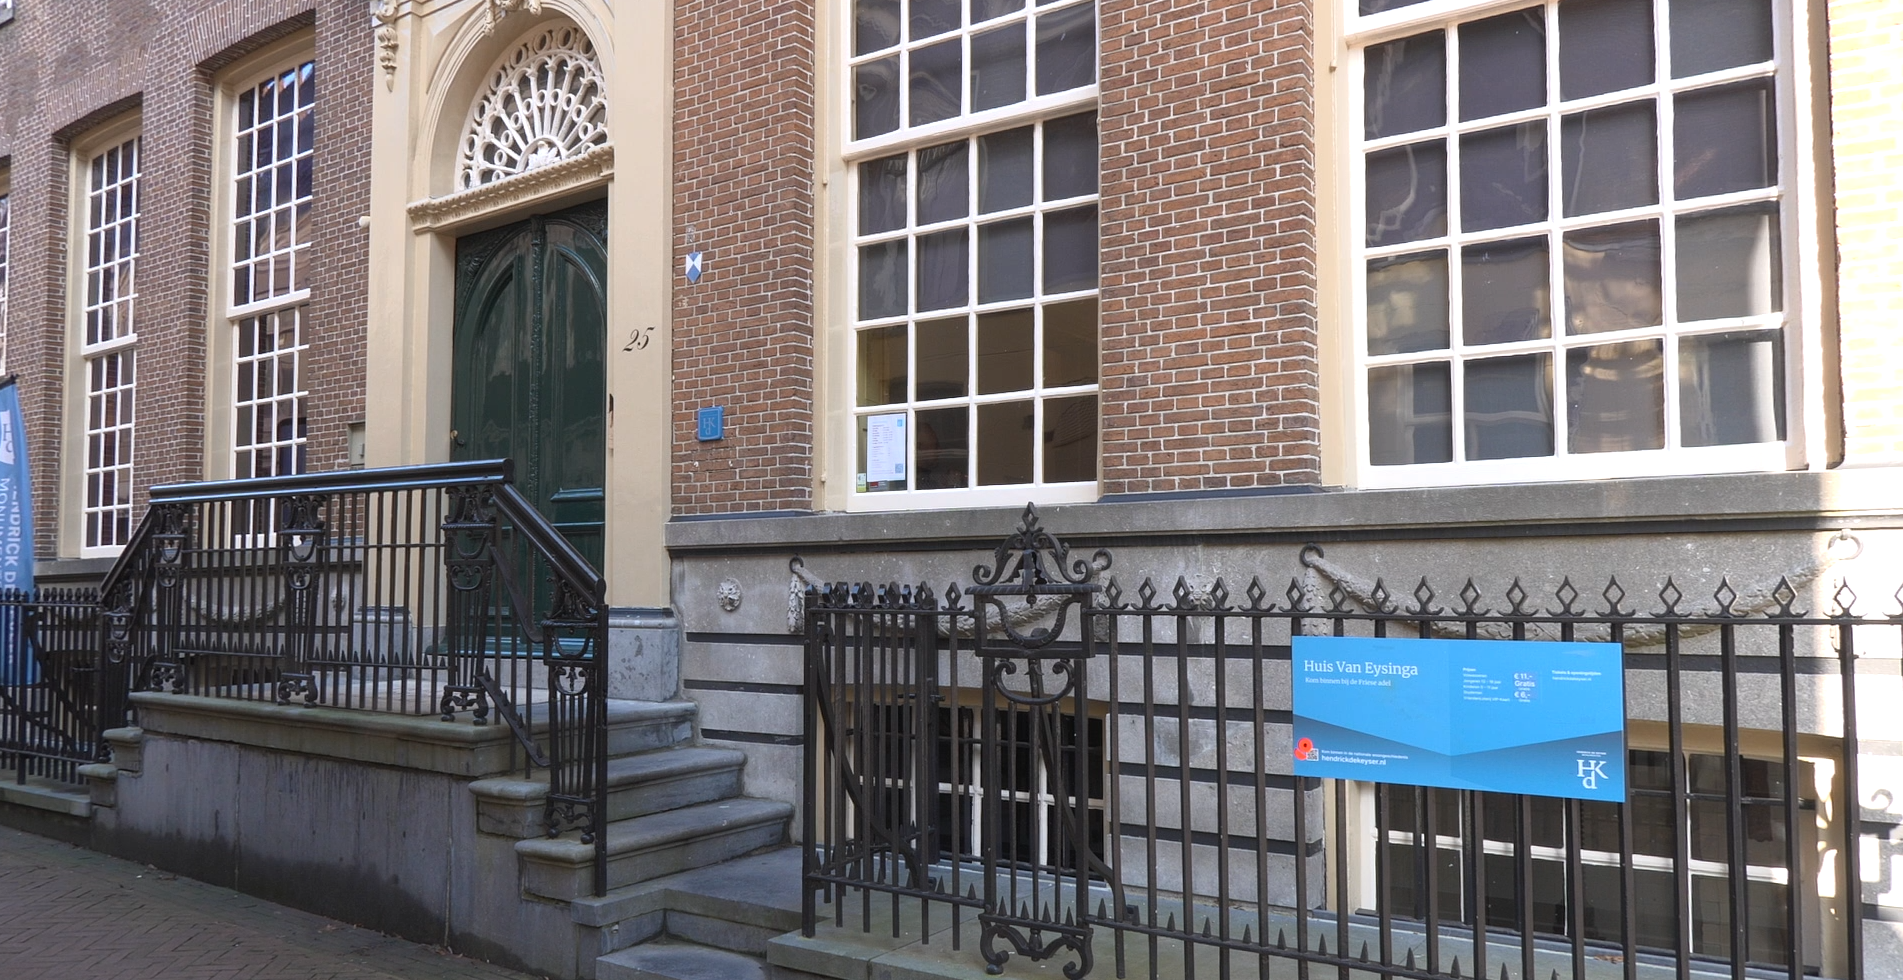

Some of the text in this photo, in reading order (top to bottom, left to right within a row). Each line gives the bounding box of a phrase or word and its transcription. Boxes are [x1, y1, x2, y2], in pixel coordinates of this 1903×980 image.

[622, 326, 655, 352] 25
[1304, 660, 1418, 679] Huis Van Eysinga
[1321, 755, 1386, 766] hendrickdekeyser.nl
